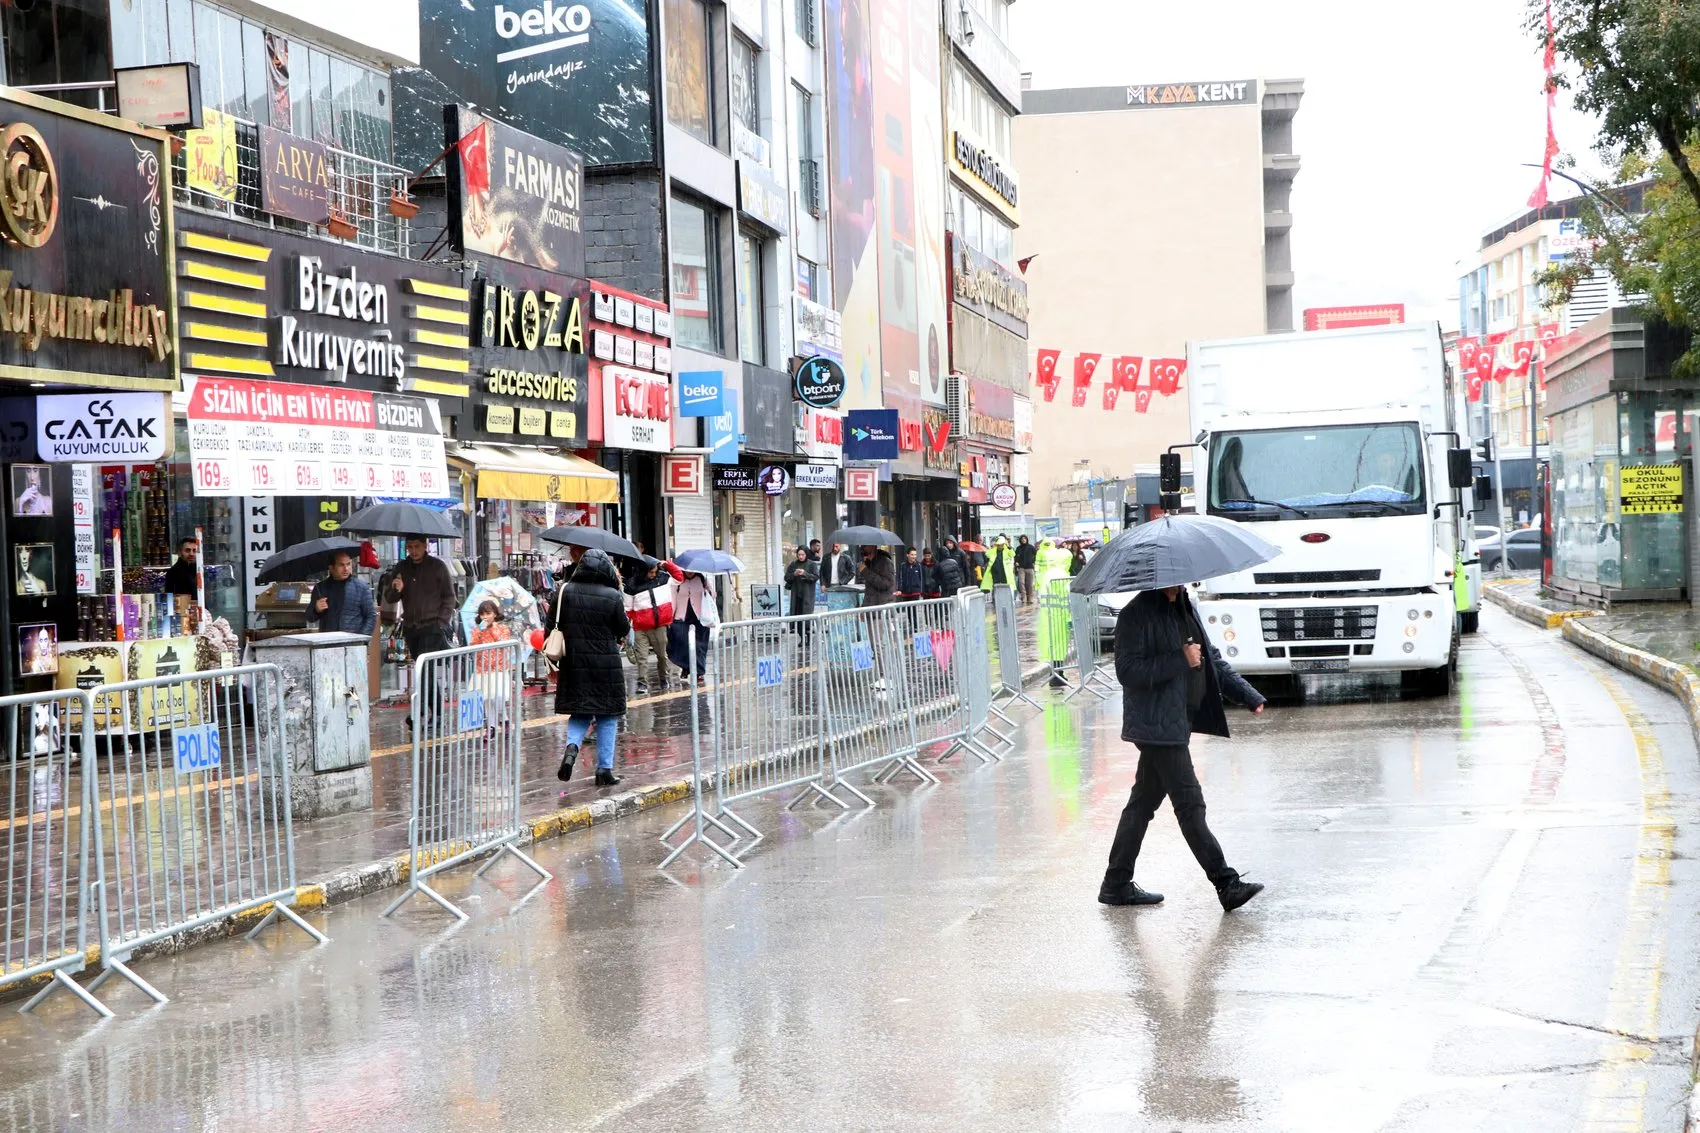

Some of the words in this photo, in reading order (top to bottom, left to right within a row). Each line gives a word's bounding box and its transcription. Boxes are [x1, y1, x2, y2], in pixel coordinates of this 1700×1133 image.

[494, 0, 591, 38] beko
[275, 142, 328, 188] ARYA
[504, 147, 580, 211] FARMASİ
[291, 185, 315, 201] CAFE
[546, 206, 581, 233] KOZMETİK
[299, 255, 389, 325] Bizden
[500, 285, 584, 355] ROZA
[282, 315, 405, 393] Kuruyemiş
[488, 367, 578, 402] accessories
[684, 383, 718, 397] beko
[803, 383, 842, 396] btpoint
[203, 384, 249, 415] SİZİN
[251, 387, 284, 421] İÇİN
[287, 397, 309, 420] EN
[311, 392, 332, 420] İYİ
[334, 391, 371, 423] FİYAT
[376, 398, 424, 429] BİZDEN
[45, 417, 157, 440] ÇATAK
[631, 425, 655, 444] SERHAT
[53, 442, 149, 456] KUYUMCULUK
[671, 463, 692, 488] E
[796, 474, 812, 483] ERKEK
[808, 466, 824, 475] VIP
[1622, 475, 1680, 484] SEZONUNU
[852, 474, 869, 494] E
[1635, 482, 1668, 491] AÇTIK
[177, 726, 221, 770] POLİS
